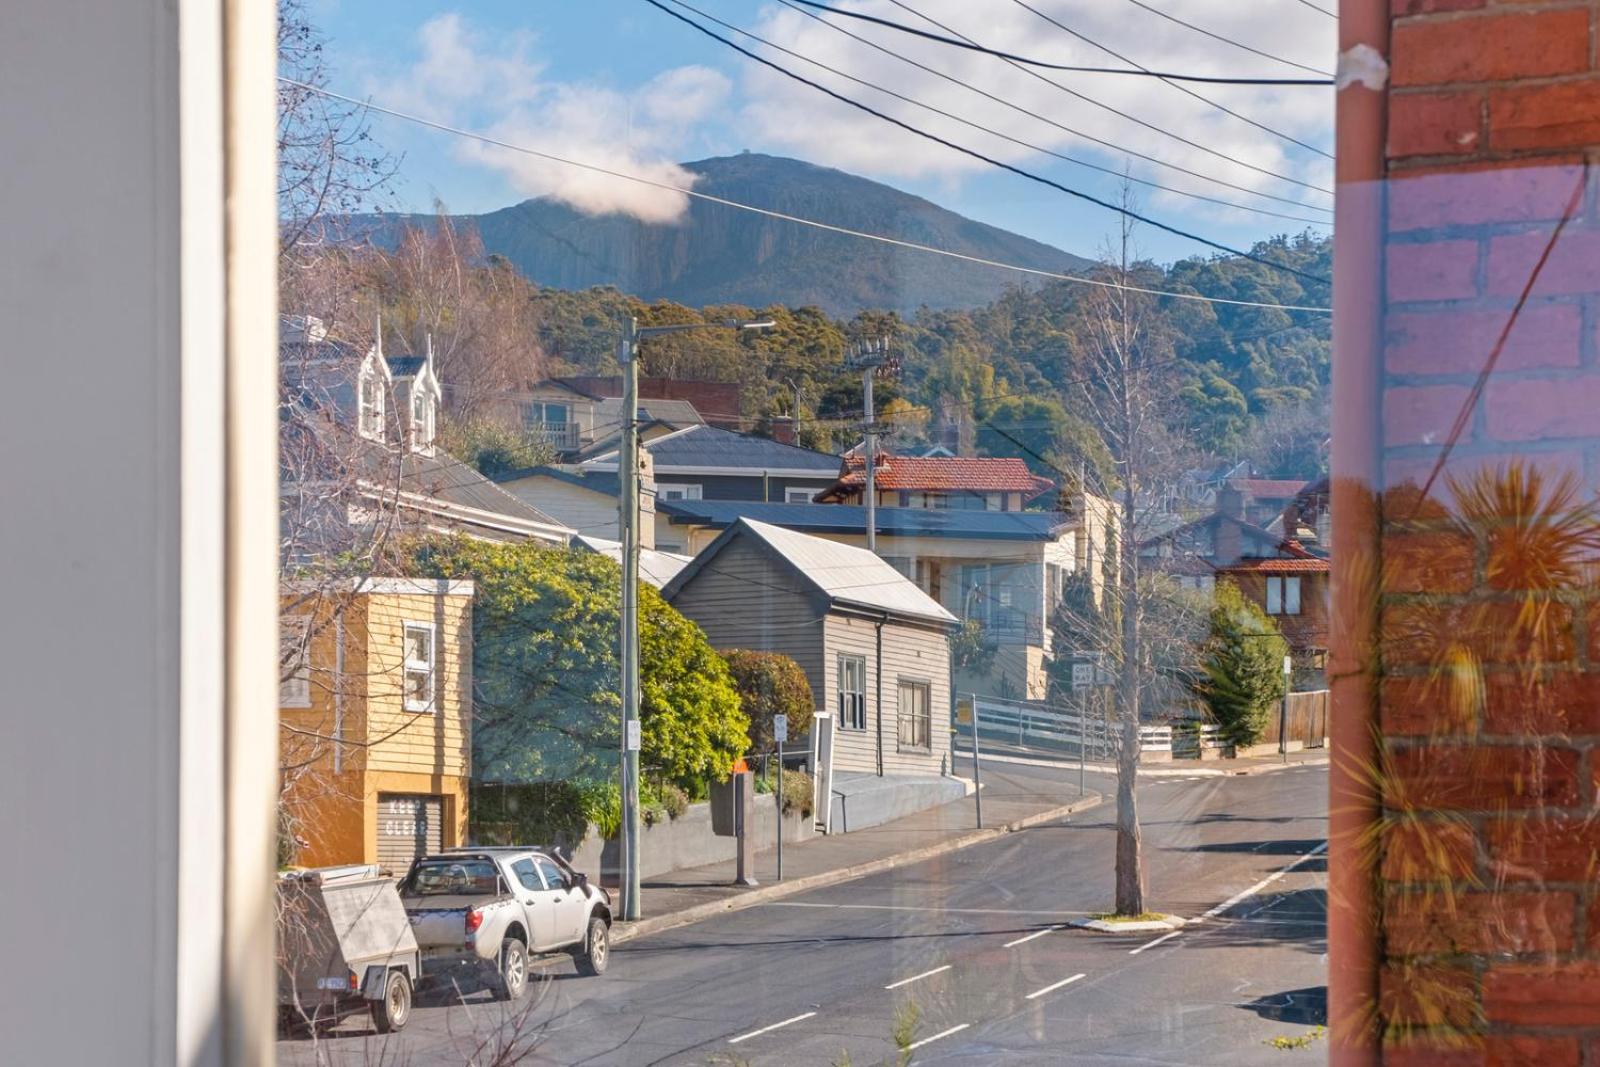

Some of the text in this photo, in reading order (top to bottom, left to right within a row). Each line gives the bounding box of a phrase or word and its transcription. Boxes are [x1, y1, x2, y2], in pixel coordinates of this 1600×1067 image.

[1075, 674, 1091, 682] WAY
[390, 800, 420, 814] KEEP
[386, 820, 426, 835] CLEAR
